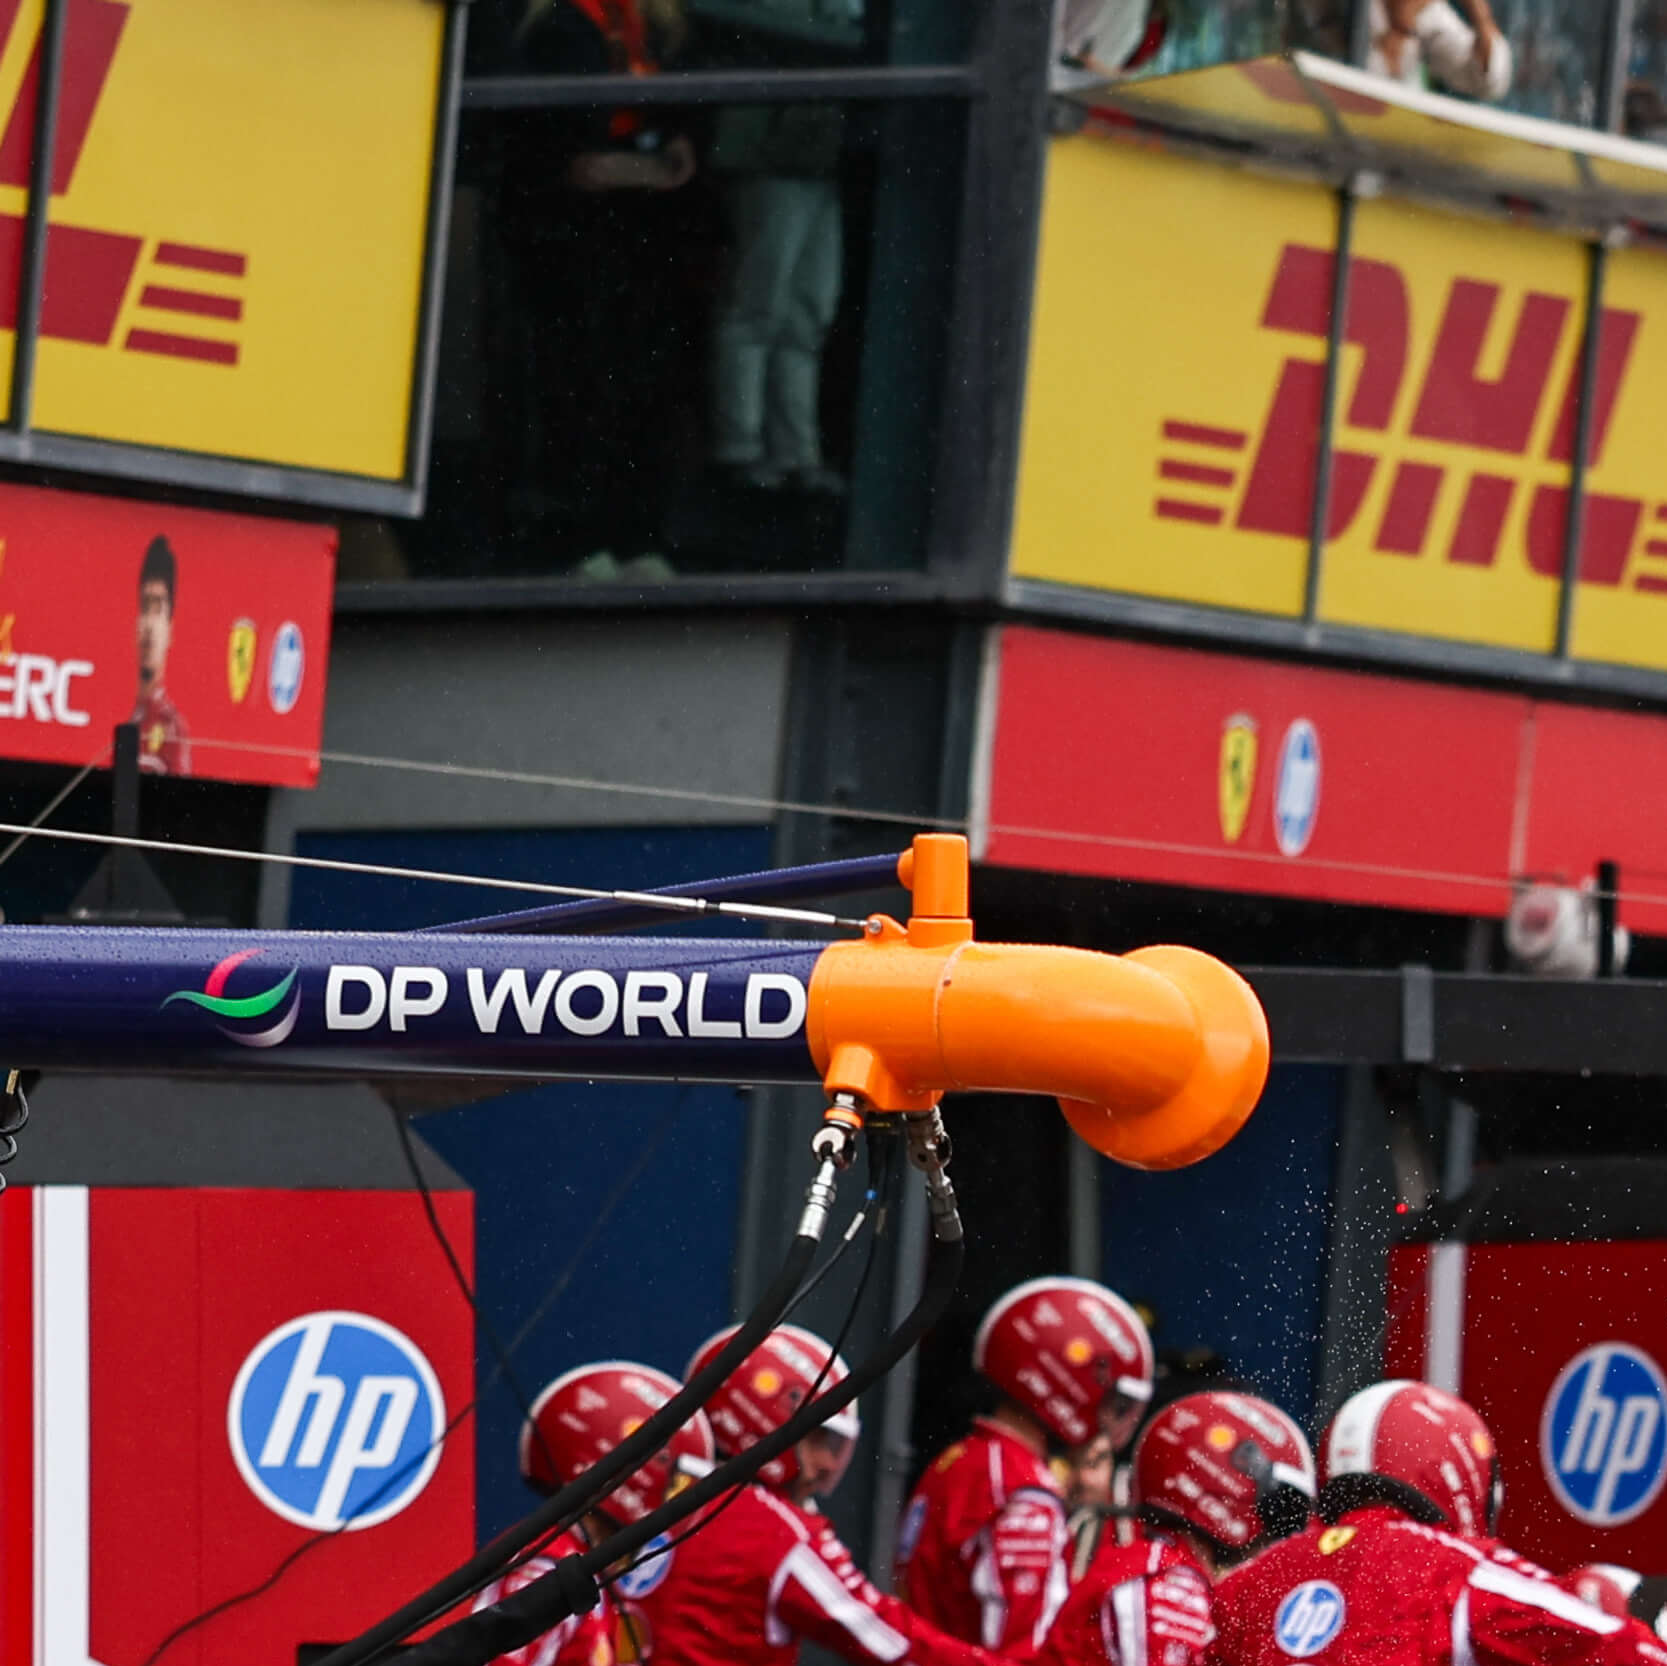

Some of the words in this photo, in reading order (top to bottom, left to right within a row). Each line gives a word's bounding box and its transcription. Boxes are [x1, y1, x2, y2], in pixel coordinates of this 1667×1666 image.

[1233, 243, 1645, 589] DHL
[325, 966, 448, 1032] DP
[467, 968, 807, 1039] WORLD
[259, 1312, 419, 1530] hp
[1560, 1347, 1661, 1521] hp
[1280, 1583, 1340, 1656] hp
